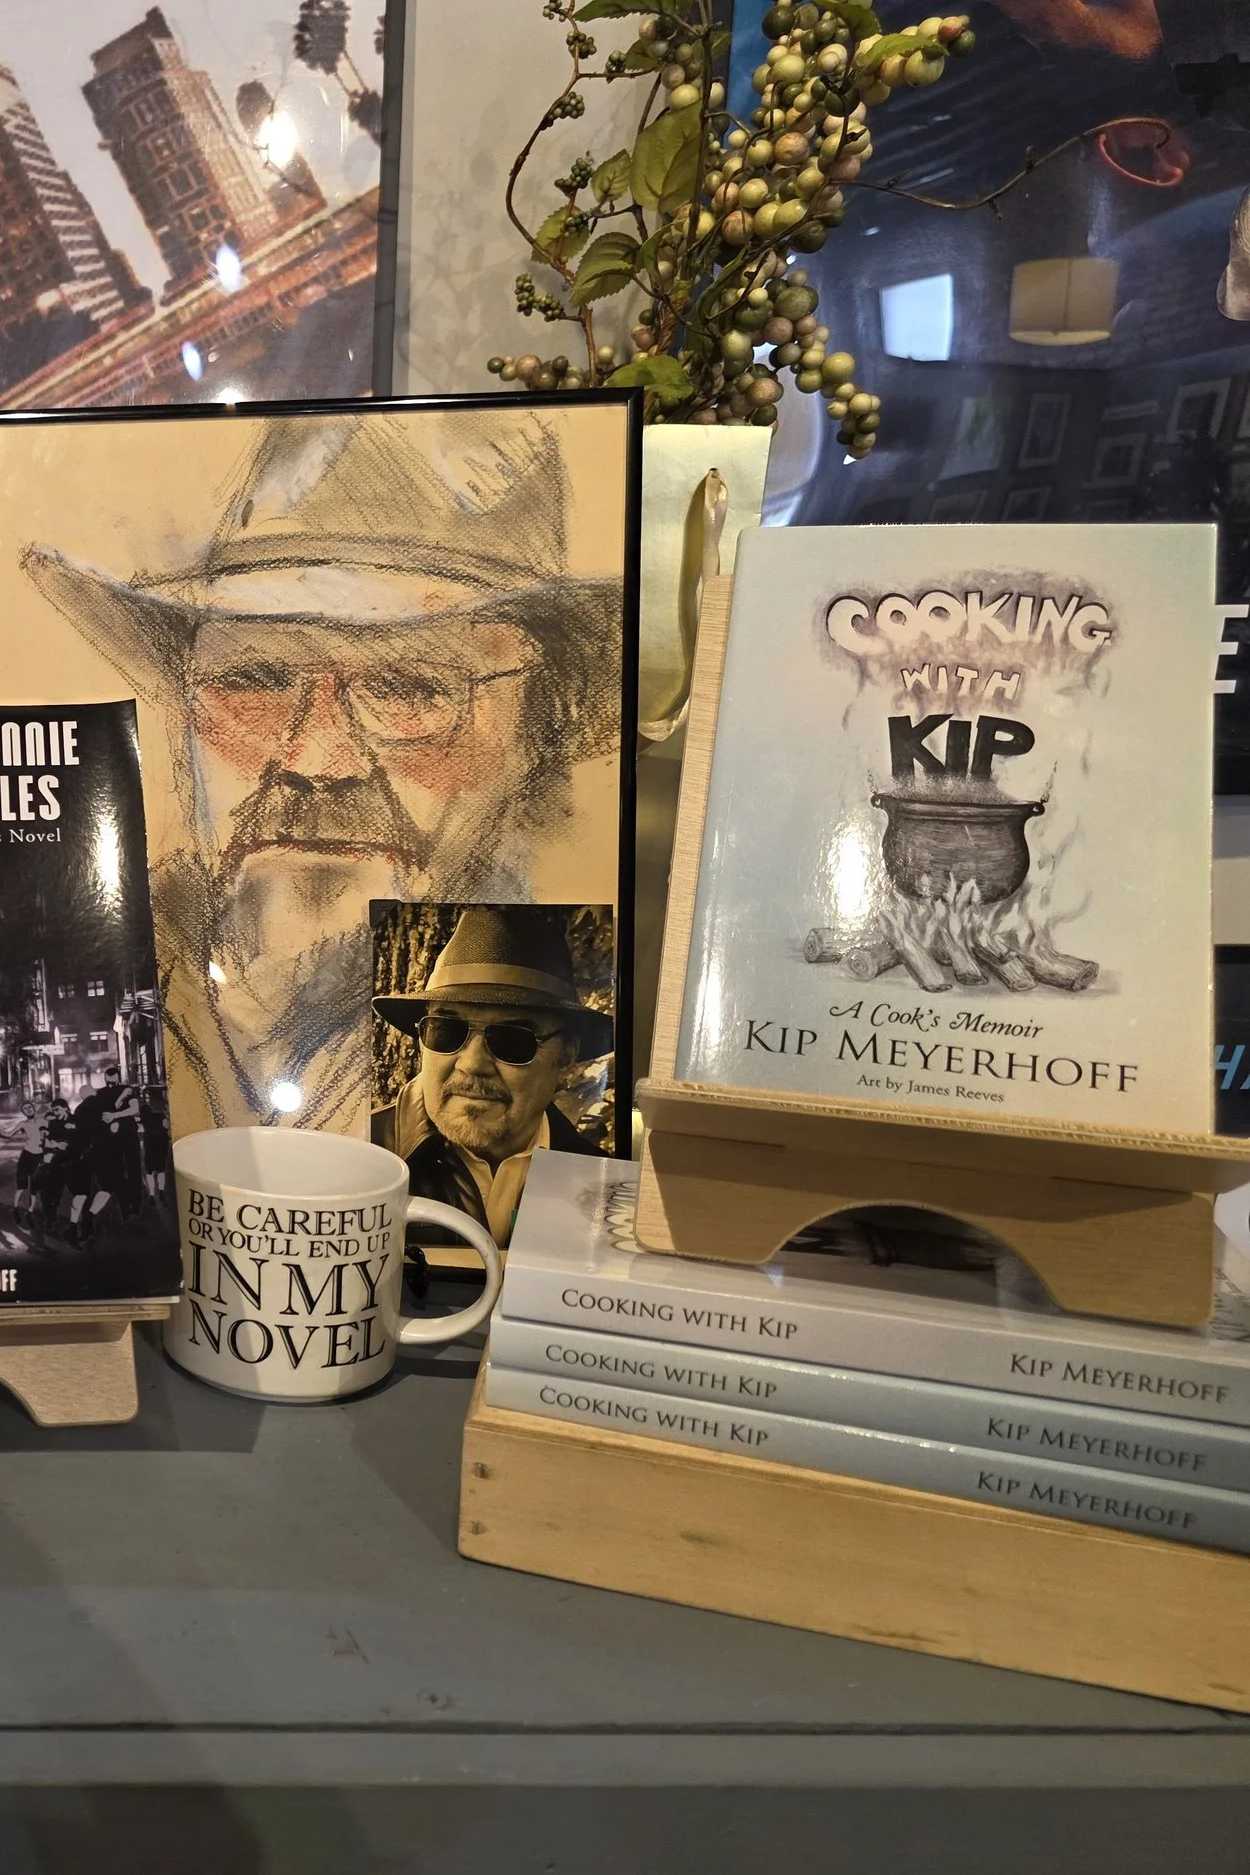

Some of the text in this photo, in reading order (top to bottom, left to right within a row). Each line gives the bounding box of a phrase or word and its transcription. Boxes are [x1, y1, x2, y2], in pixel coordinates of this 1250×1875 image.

[827, 590, 1113, 655] COOKING
[901, 663, 1021, 701] WITH
[887, 713, 1036, 779] KIP
[9, 827, 61, 844] Novel
[829, 1001, 1044, 1039] A Cook's Memoir
[744, 1019, 1139, 1093] KIP MEYERHOFF
[1213, 1045, 1250, 1090] H
[856, 1074, 1005, 1103] Art by James Reeves
[188, 1189, 393, 1236] BE CAREFUL
[188, 1218, 391, 1259] OR YOU'LL END UP
[188, 1240, 390, 1317] IN MY
[188, 1298, 387, 1369] NOVEL
[561, 1288, 798, 1340] COOKING WITH KIP
[545, 1344, 777, 1399] COOKING WITH KIP
[1010, 1353, 1230, 1405] KIP MEYERHOFF
[539, 1385, 770, 1447] COOKING WITH KIP
[987, 1418, 1208, 1473] KIP MEYERHOFF
[977, 1471, 1199, 1530] KIP MEYERHOFF
